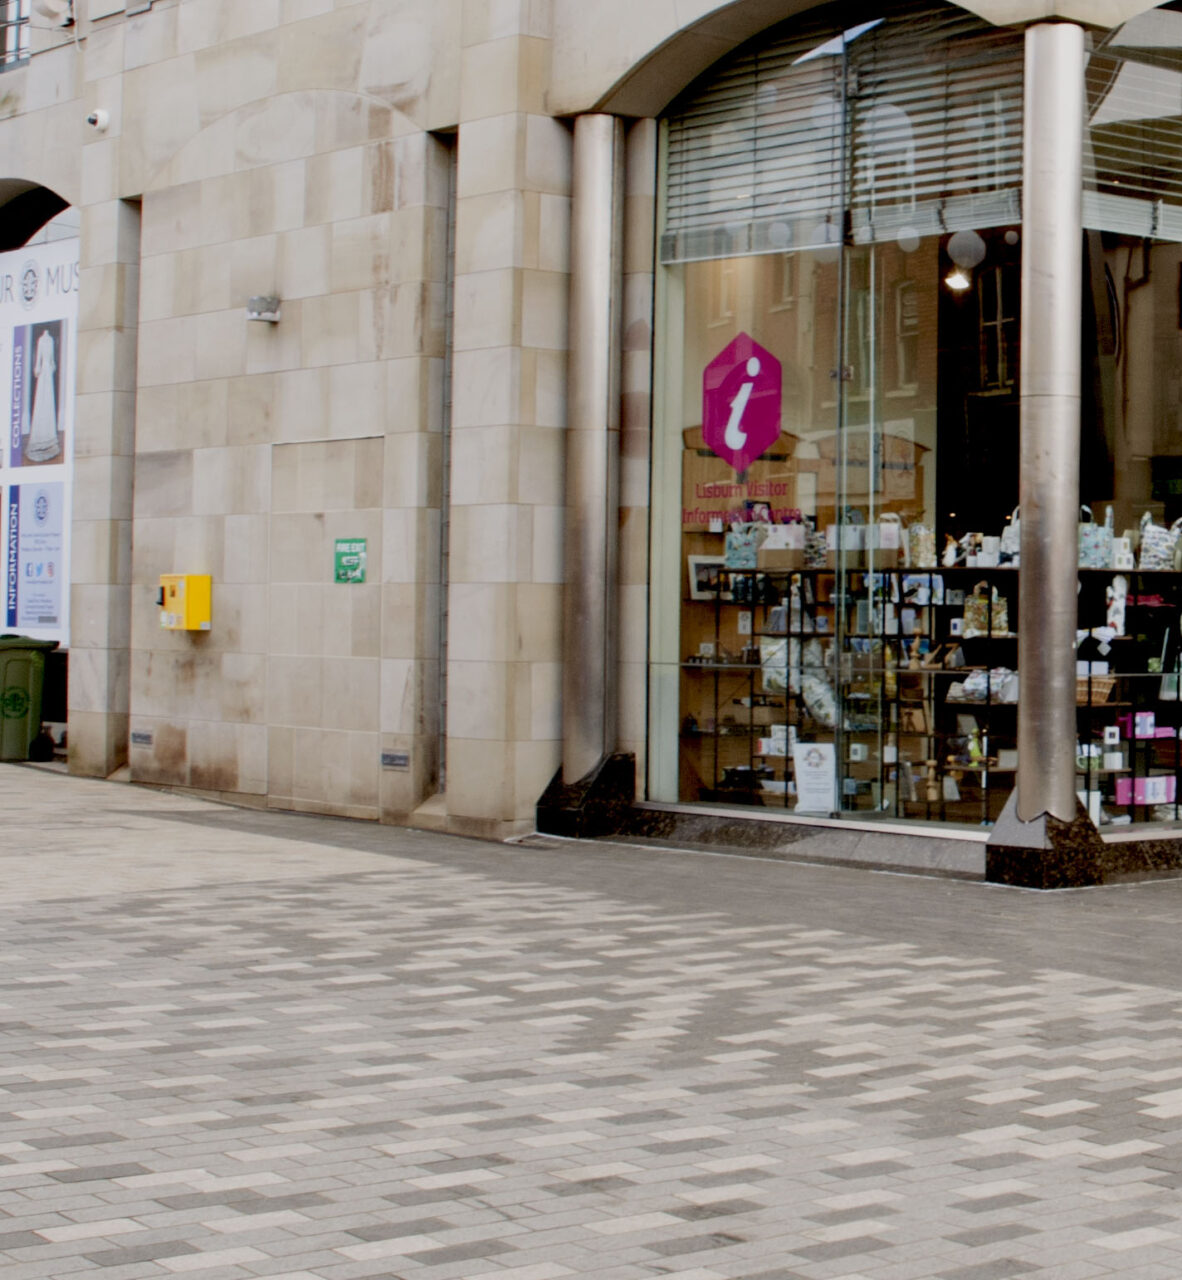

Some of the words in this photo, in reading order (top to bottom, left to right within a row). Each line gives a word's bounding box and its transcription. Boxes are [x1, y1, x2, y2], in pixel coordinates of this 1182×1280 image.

[12, 345, 22, 449] COLLECTIONS
[695, 483, 743, 499] Lisburn
[746, 480, 789, 497] Visitor
[8, 503, 18, 610] INFORMATION
